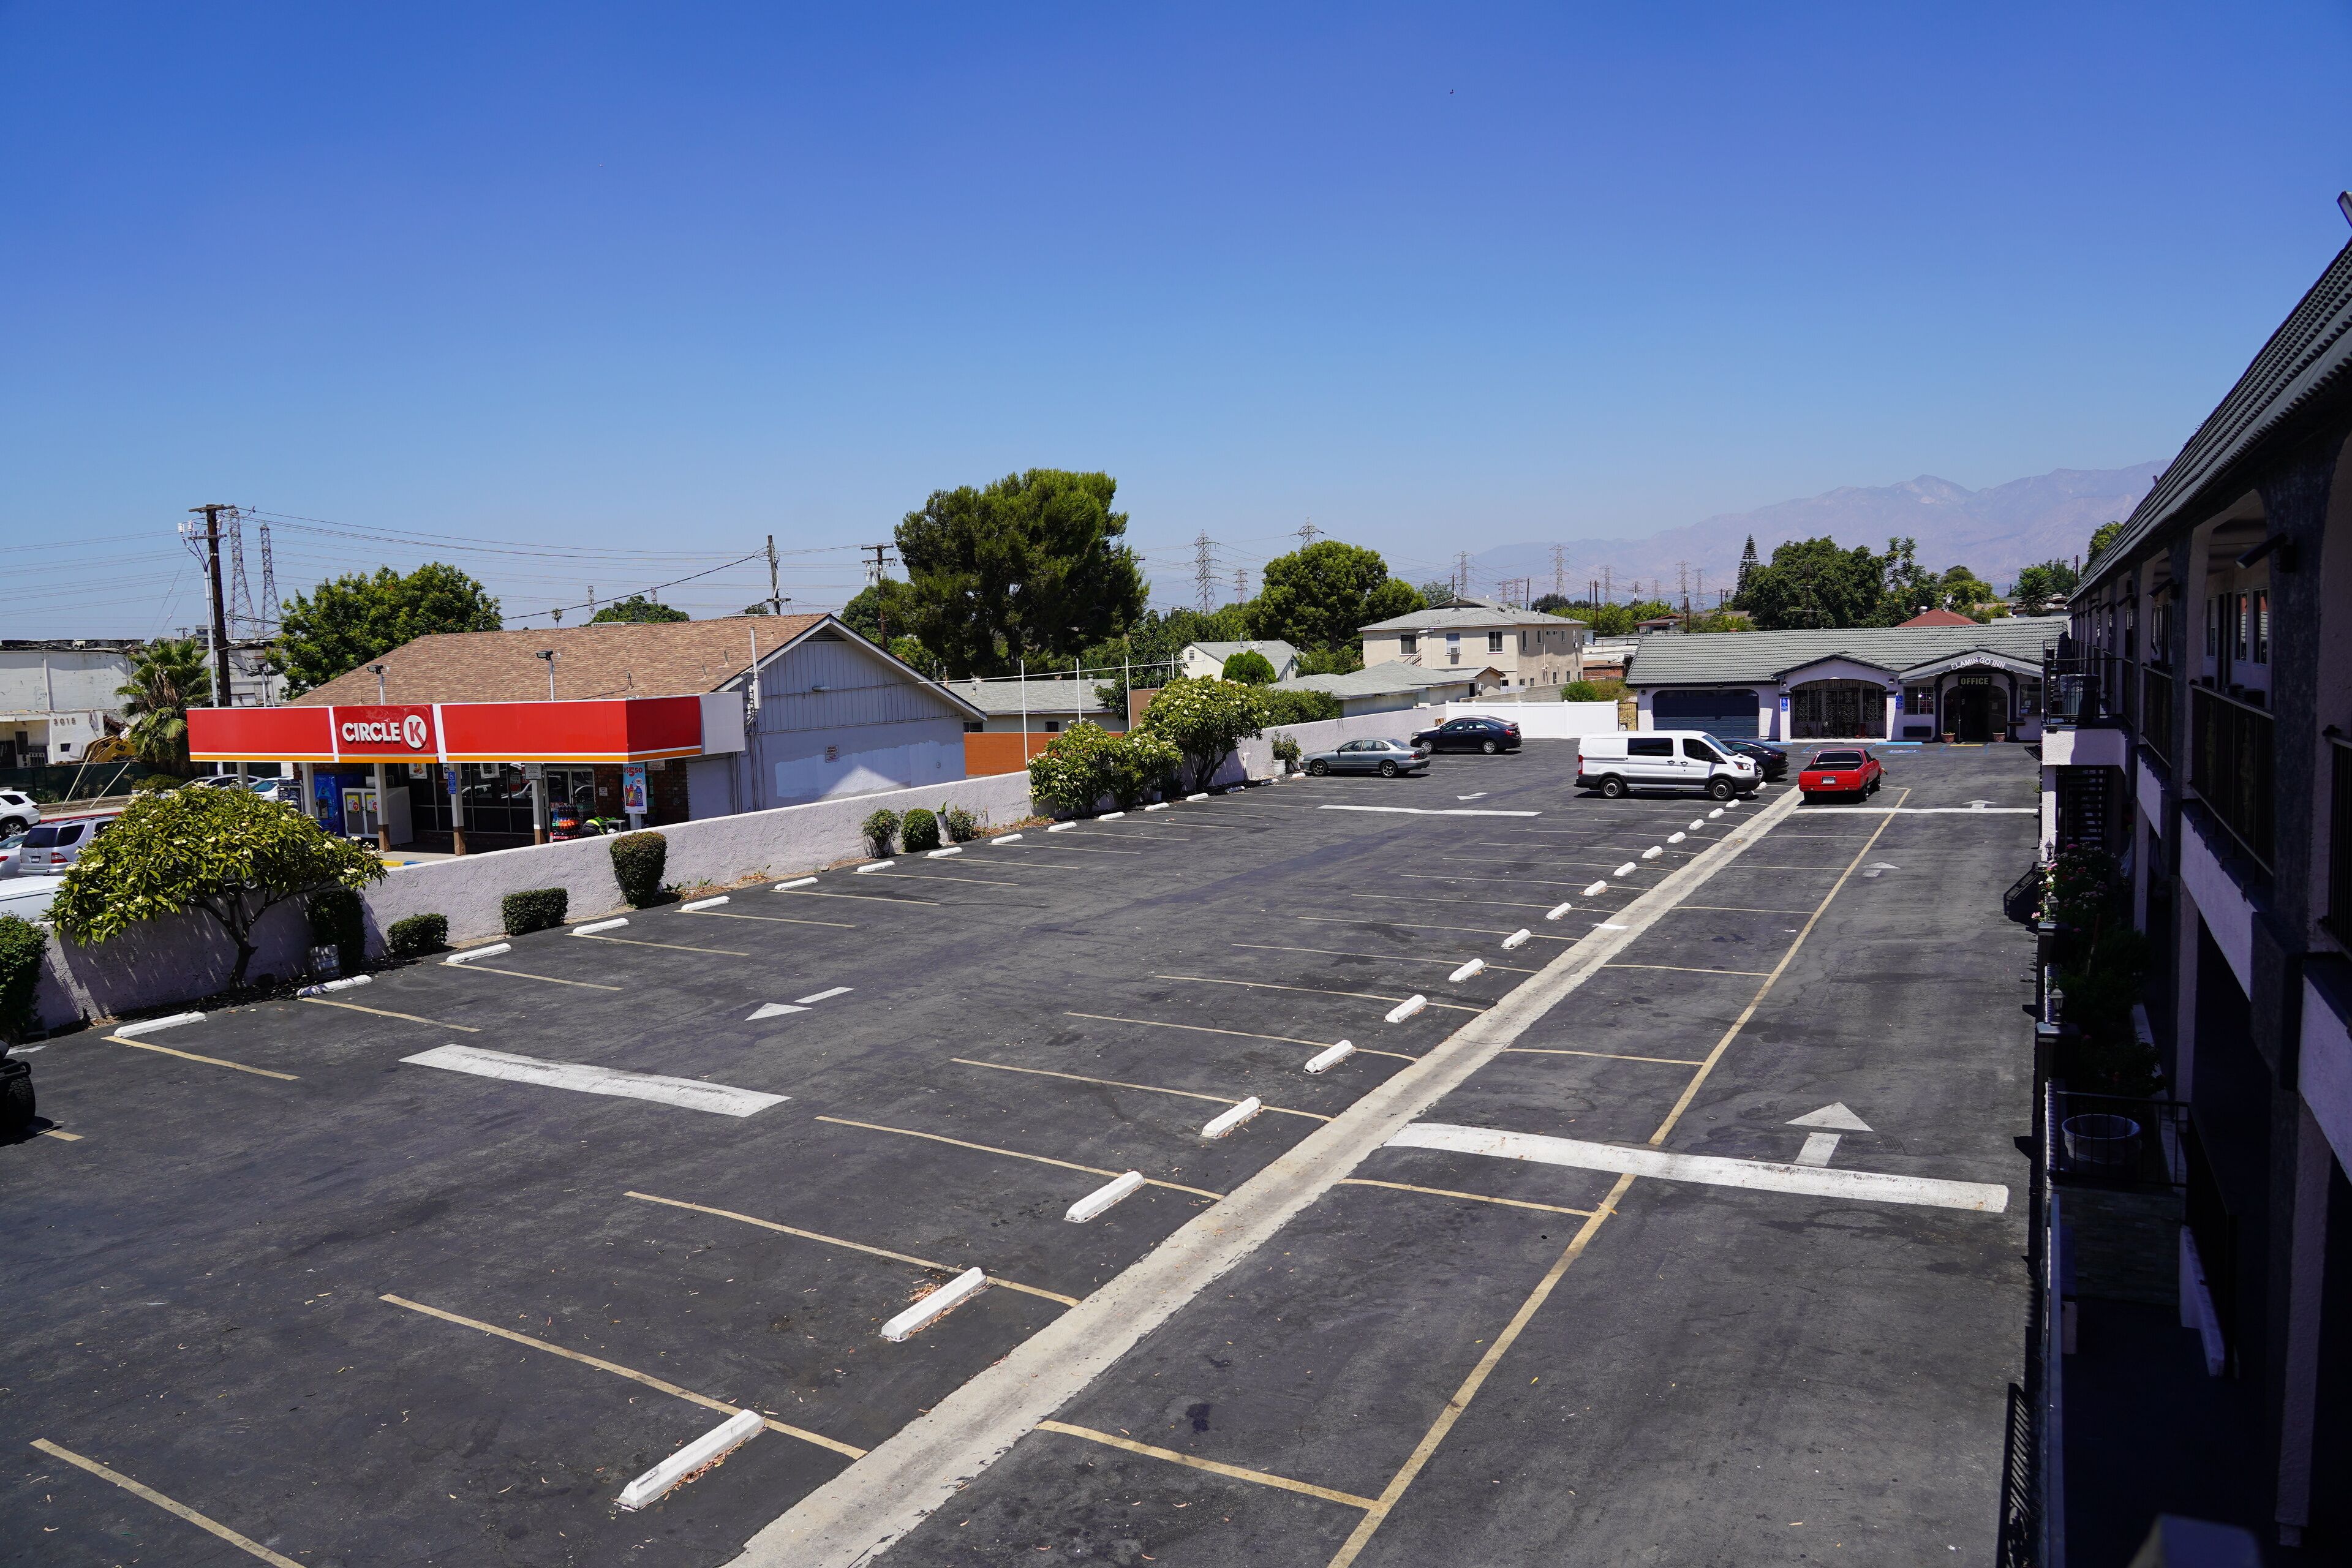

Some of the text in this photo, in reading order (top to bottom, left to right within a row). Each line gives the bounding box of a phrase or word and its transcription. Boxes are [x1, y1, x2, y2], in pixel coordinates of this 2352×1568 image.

[1951, 657, 2006, 669] FLAMINGO INN
[53, 717, 76, 726] 3015
[342, 721, 425, 747] CIRCLE K
[115, 743, 127, 752] CAT
